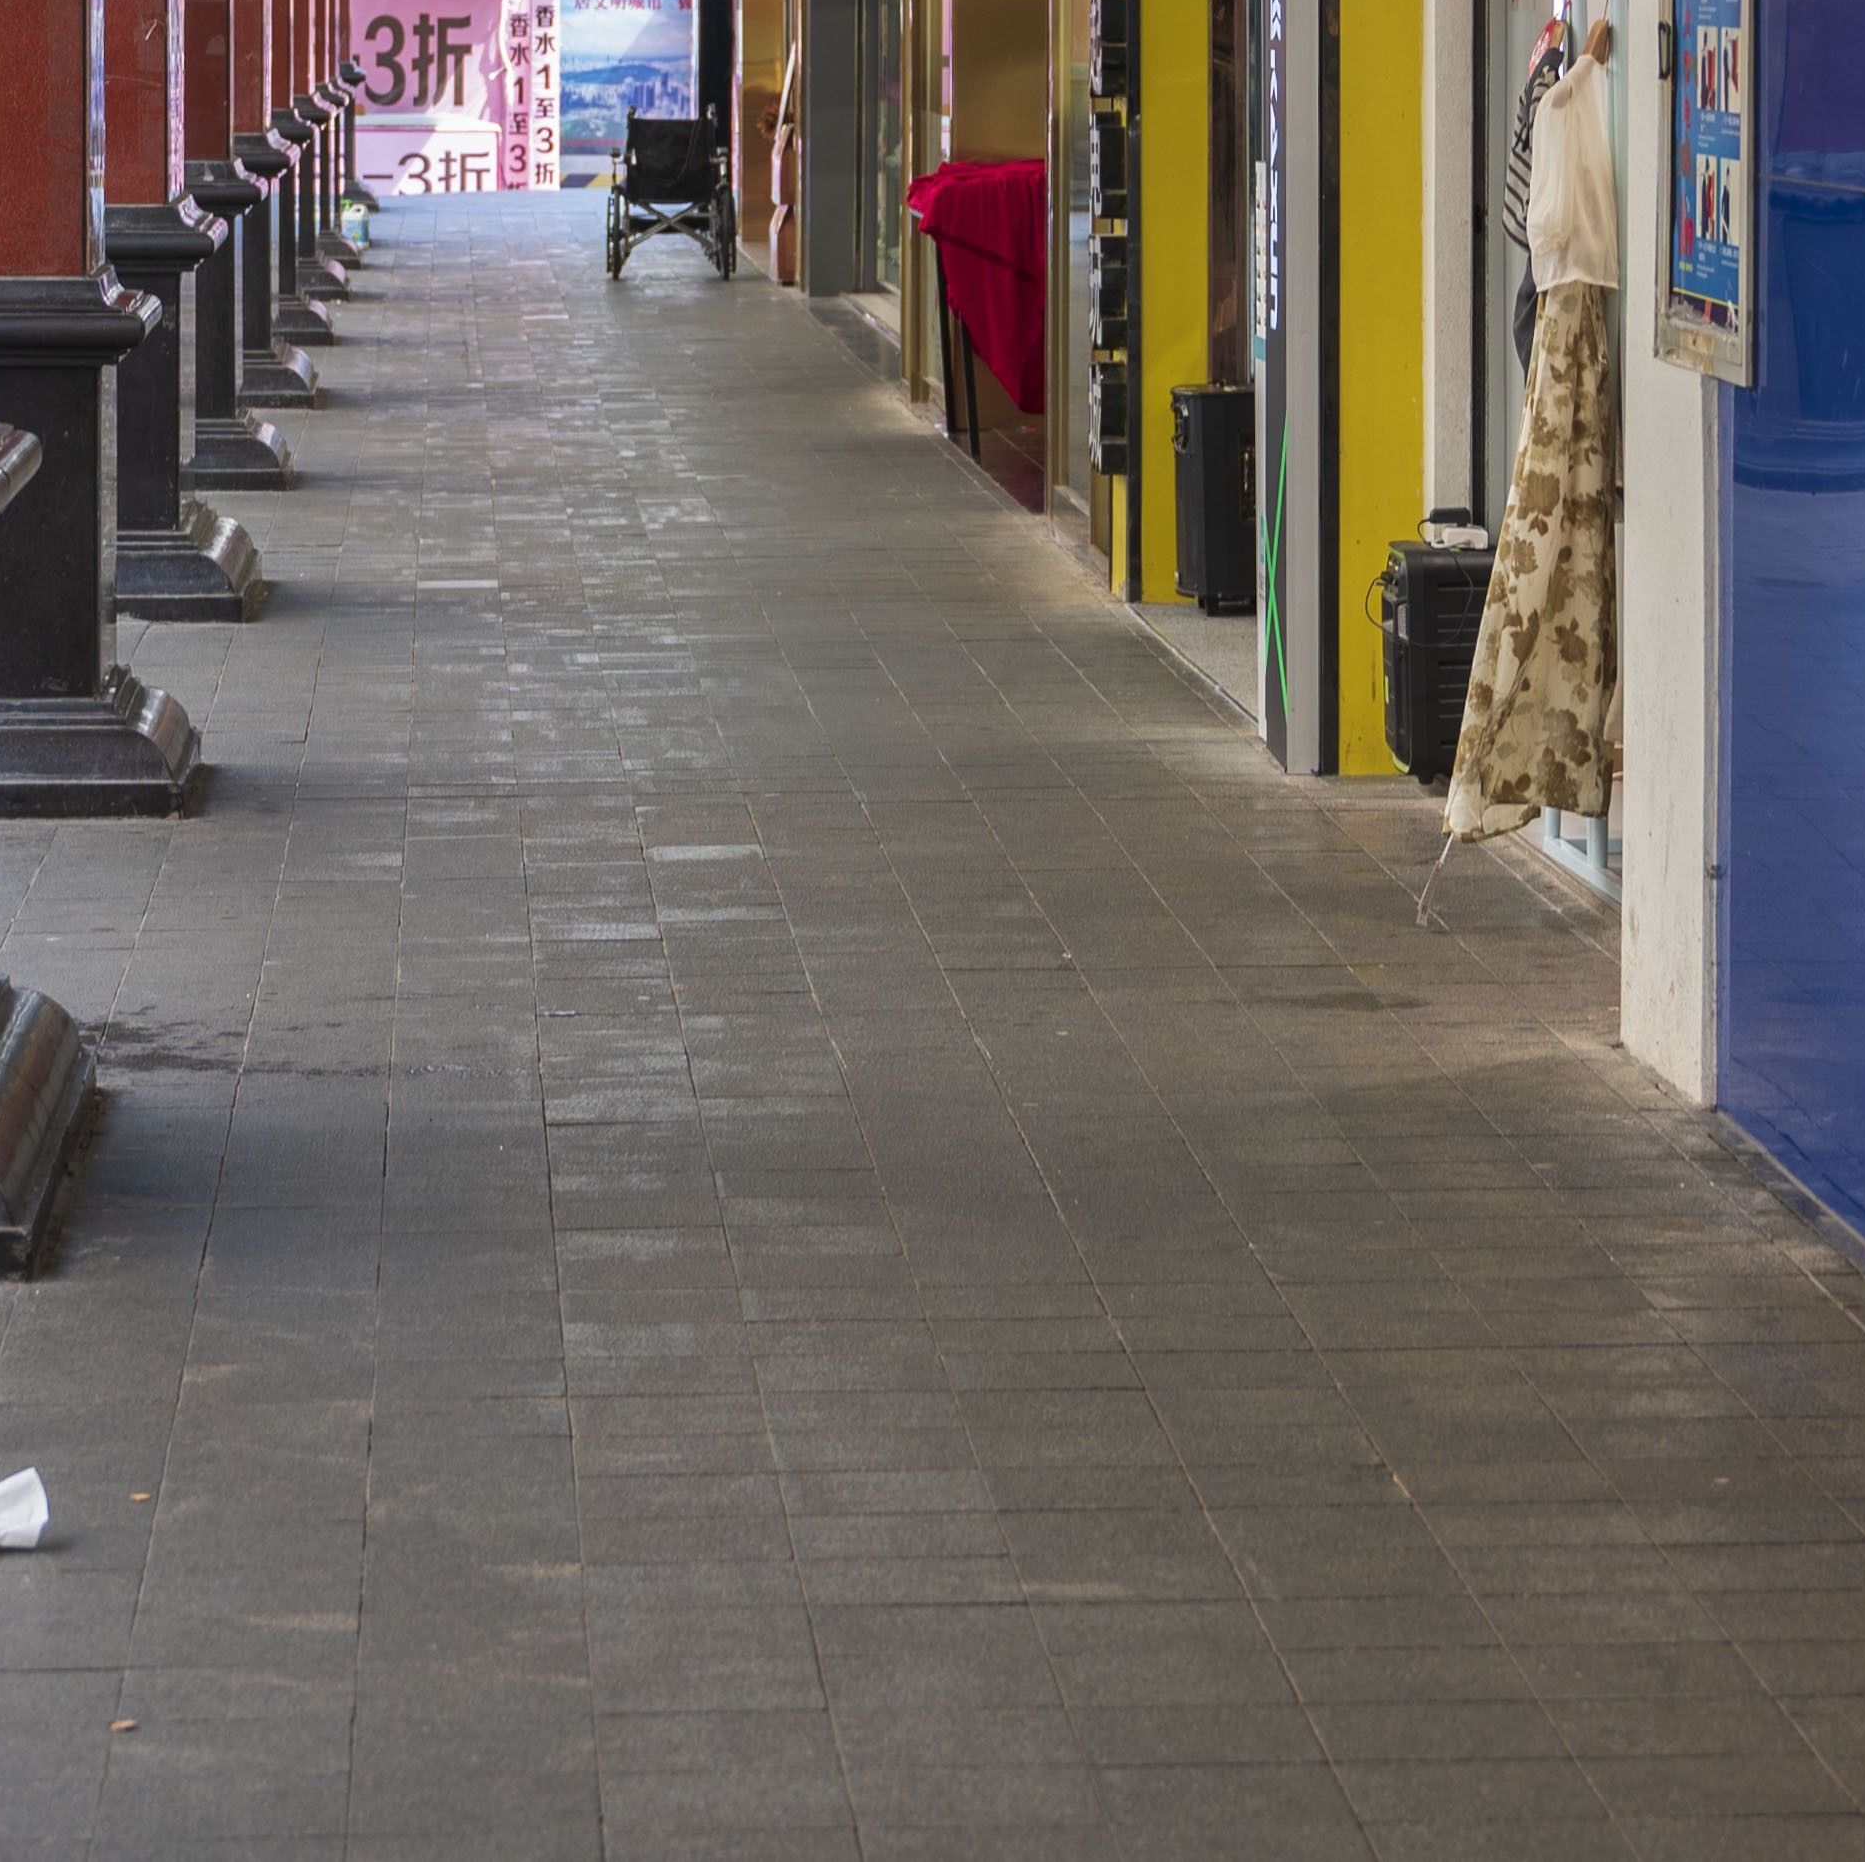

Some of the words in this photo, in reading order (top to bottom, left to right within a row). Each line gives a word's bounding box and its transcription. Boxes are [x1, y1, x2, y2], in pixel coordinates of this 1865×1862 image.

[352, 13, 472, 107] 3折
[534, 4, 556, 185] 香水1至3折
